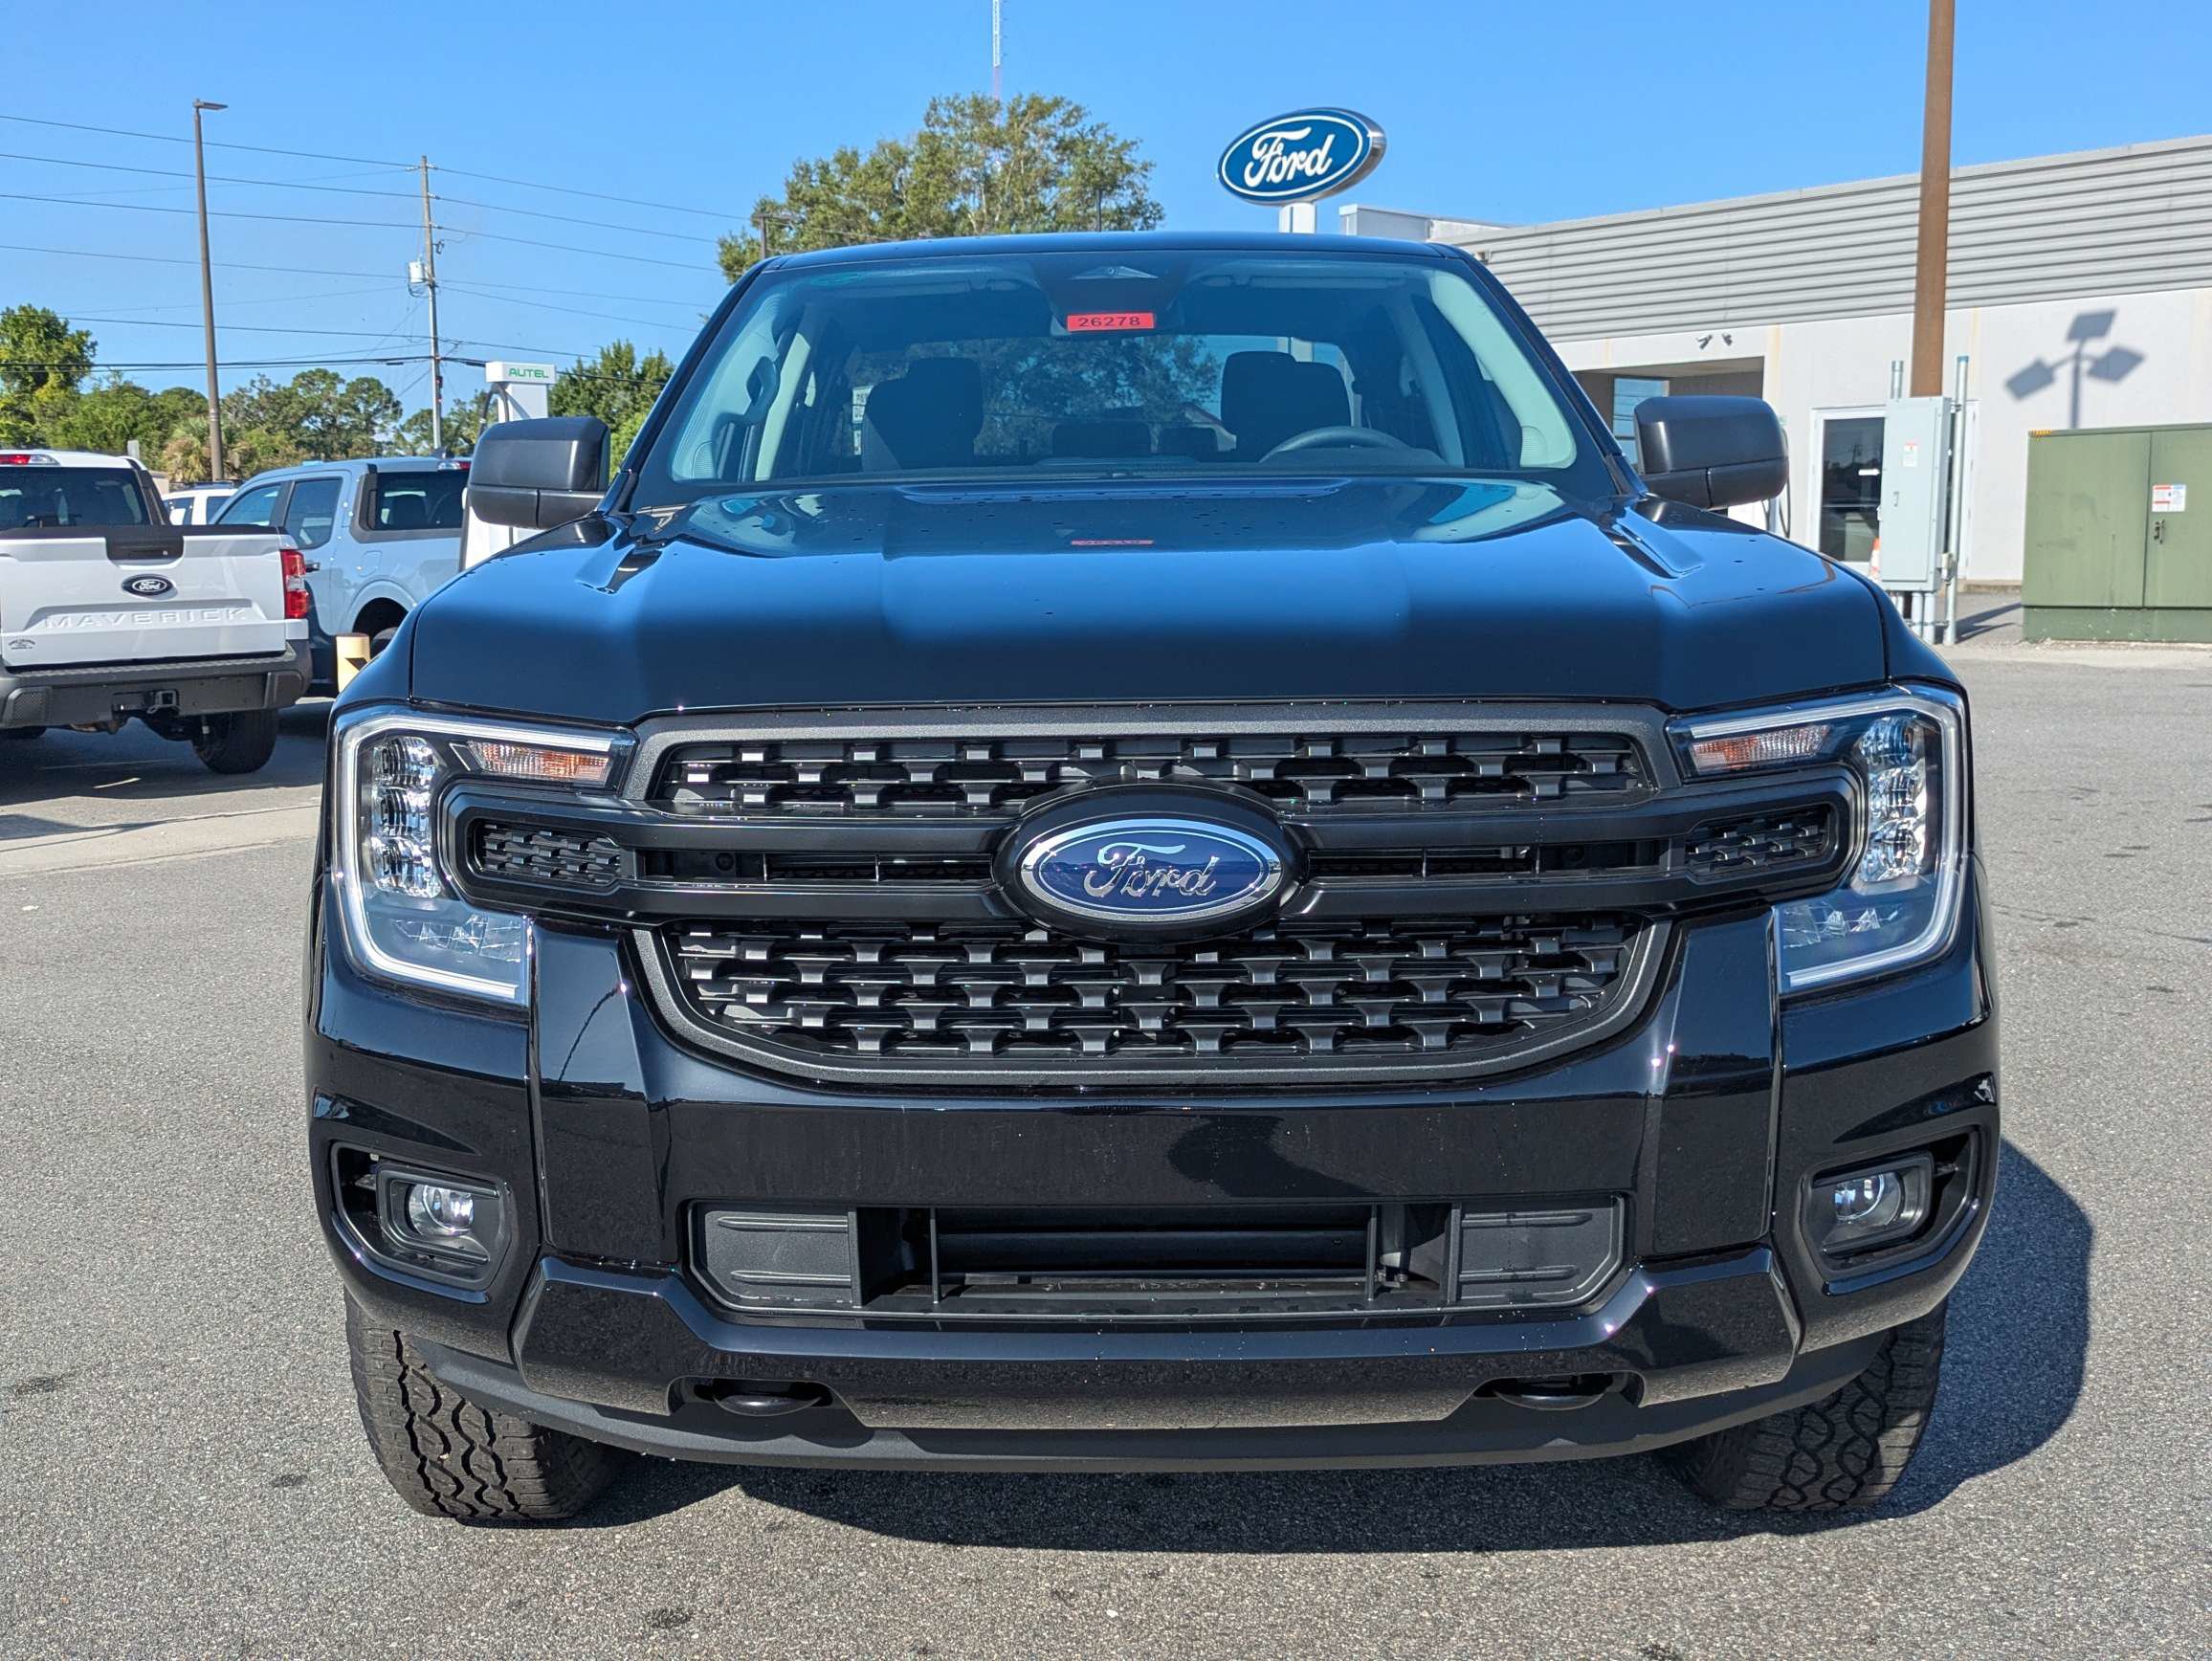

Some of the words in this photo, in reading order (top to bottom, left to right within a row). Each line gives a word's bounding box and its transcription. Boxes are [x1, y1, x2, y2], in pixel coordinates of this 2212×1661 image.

[1244, 126, 1336, 188] Ford
[1078, 316, 1141, 327] 26278
[508, 367, 549, 379] AUTEL
[139, 579, 162, 592] Ford
[45, 608, 249, 630] MAVERICK
[1083, 841, 1221, 897] Ford
